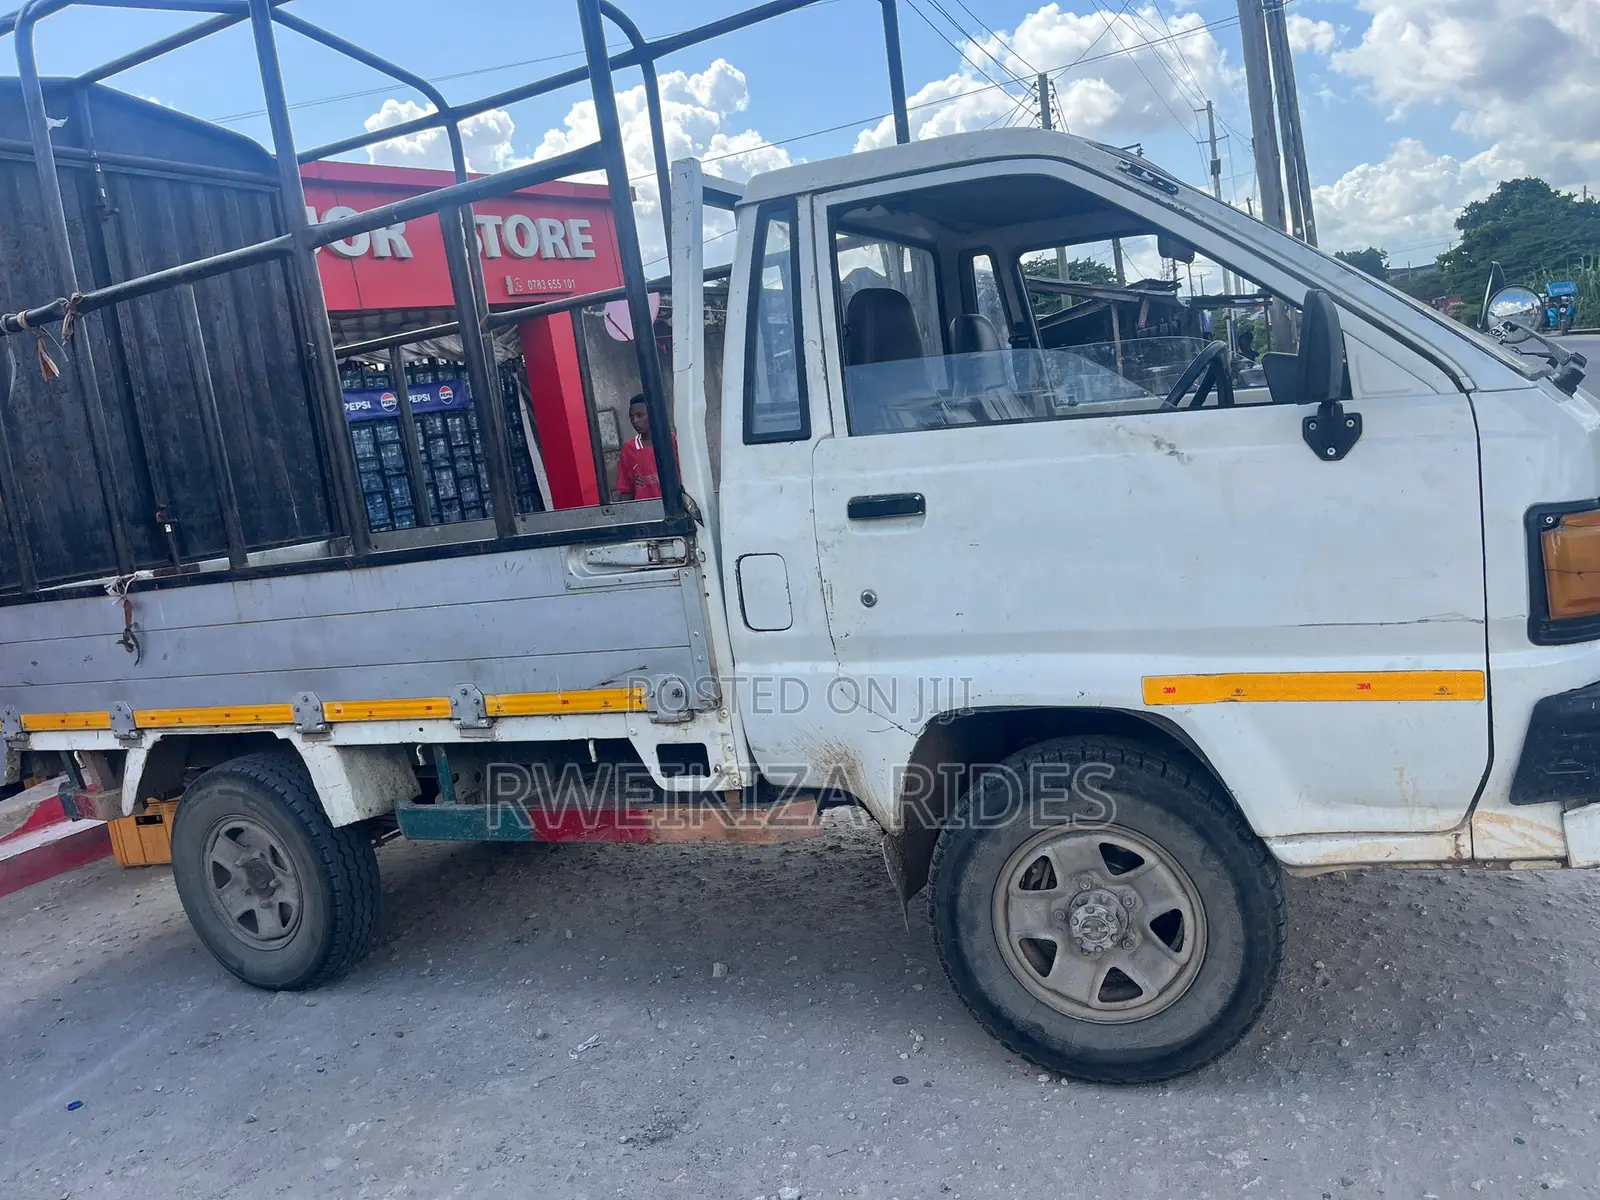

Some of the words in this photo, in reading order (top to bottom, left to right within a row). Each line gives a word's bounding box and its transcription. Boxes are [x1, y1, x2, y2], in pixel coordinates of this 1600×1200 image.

[475, 214, 596, 259] TORE
[527, 279, 547, 290] 0783
[548, 279, 562, 290] 655
[563, 278, 576, 289] 101
[1163, 686, 1176, 694] 3M
